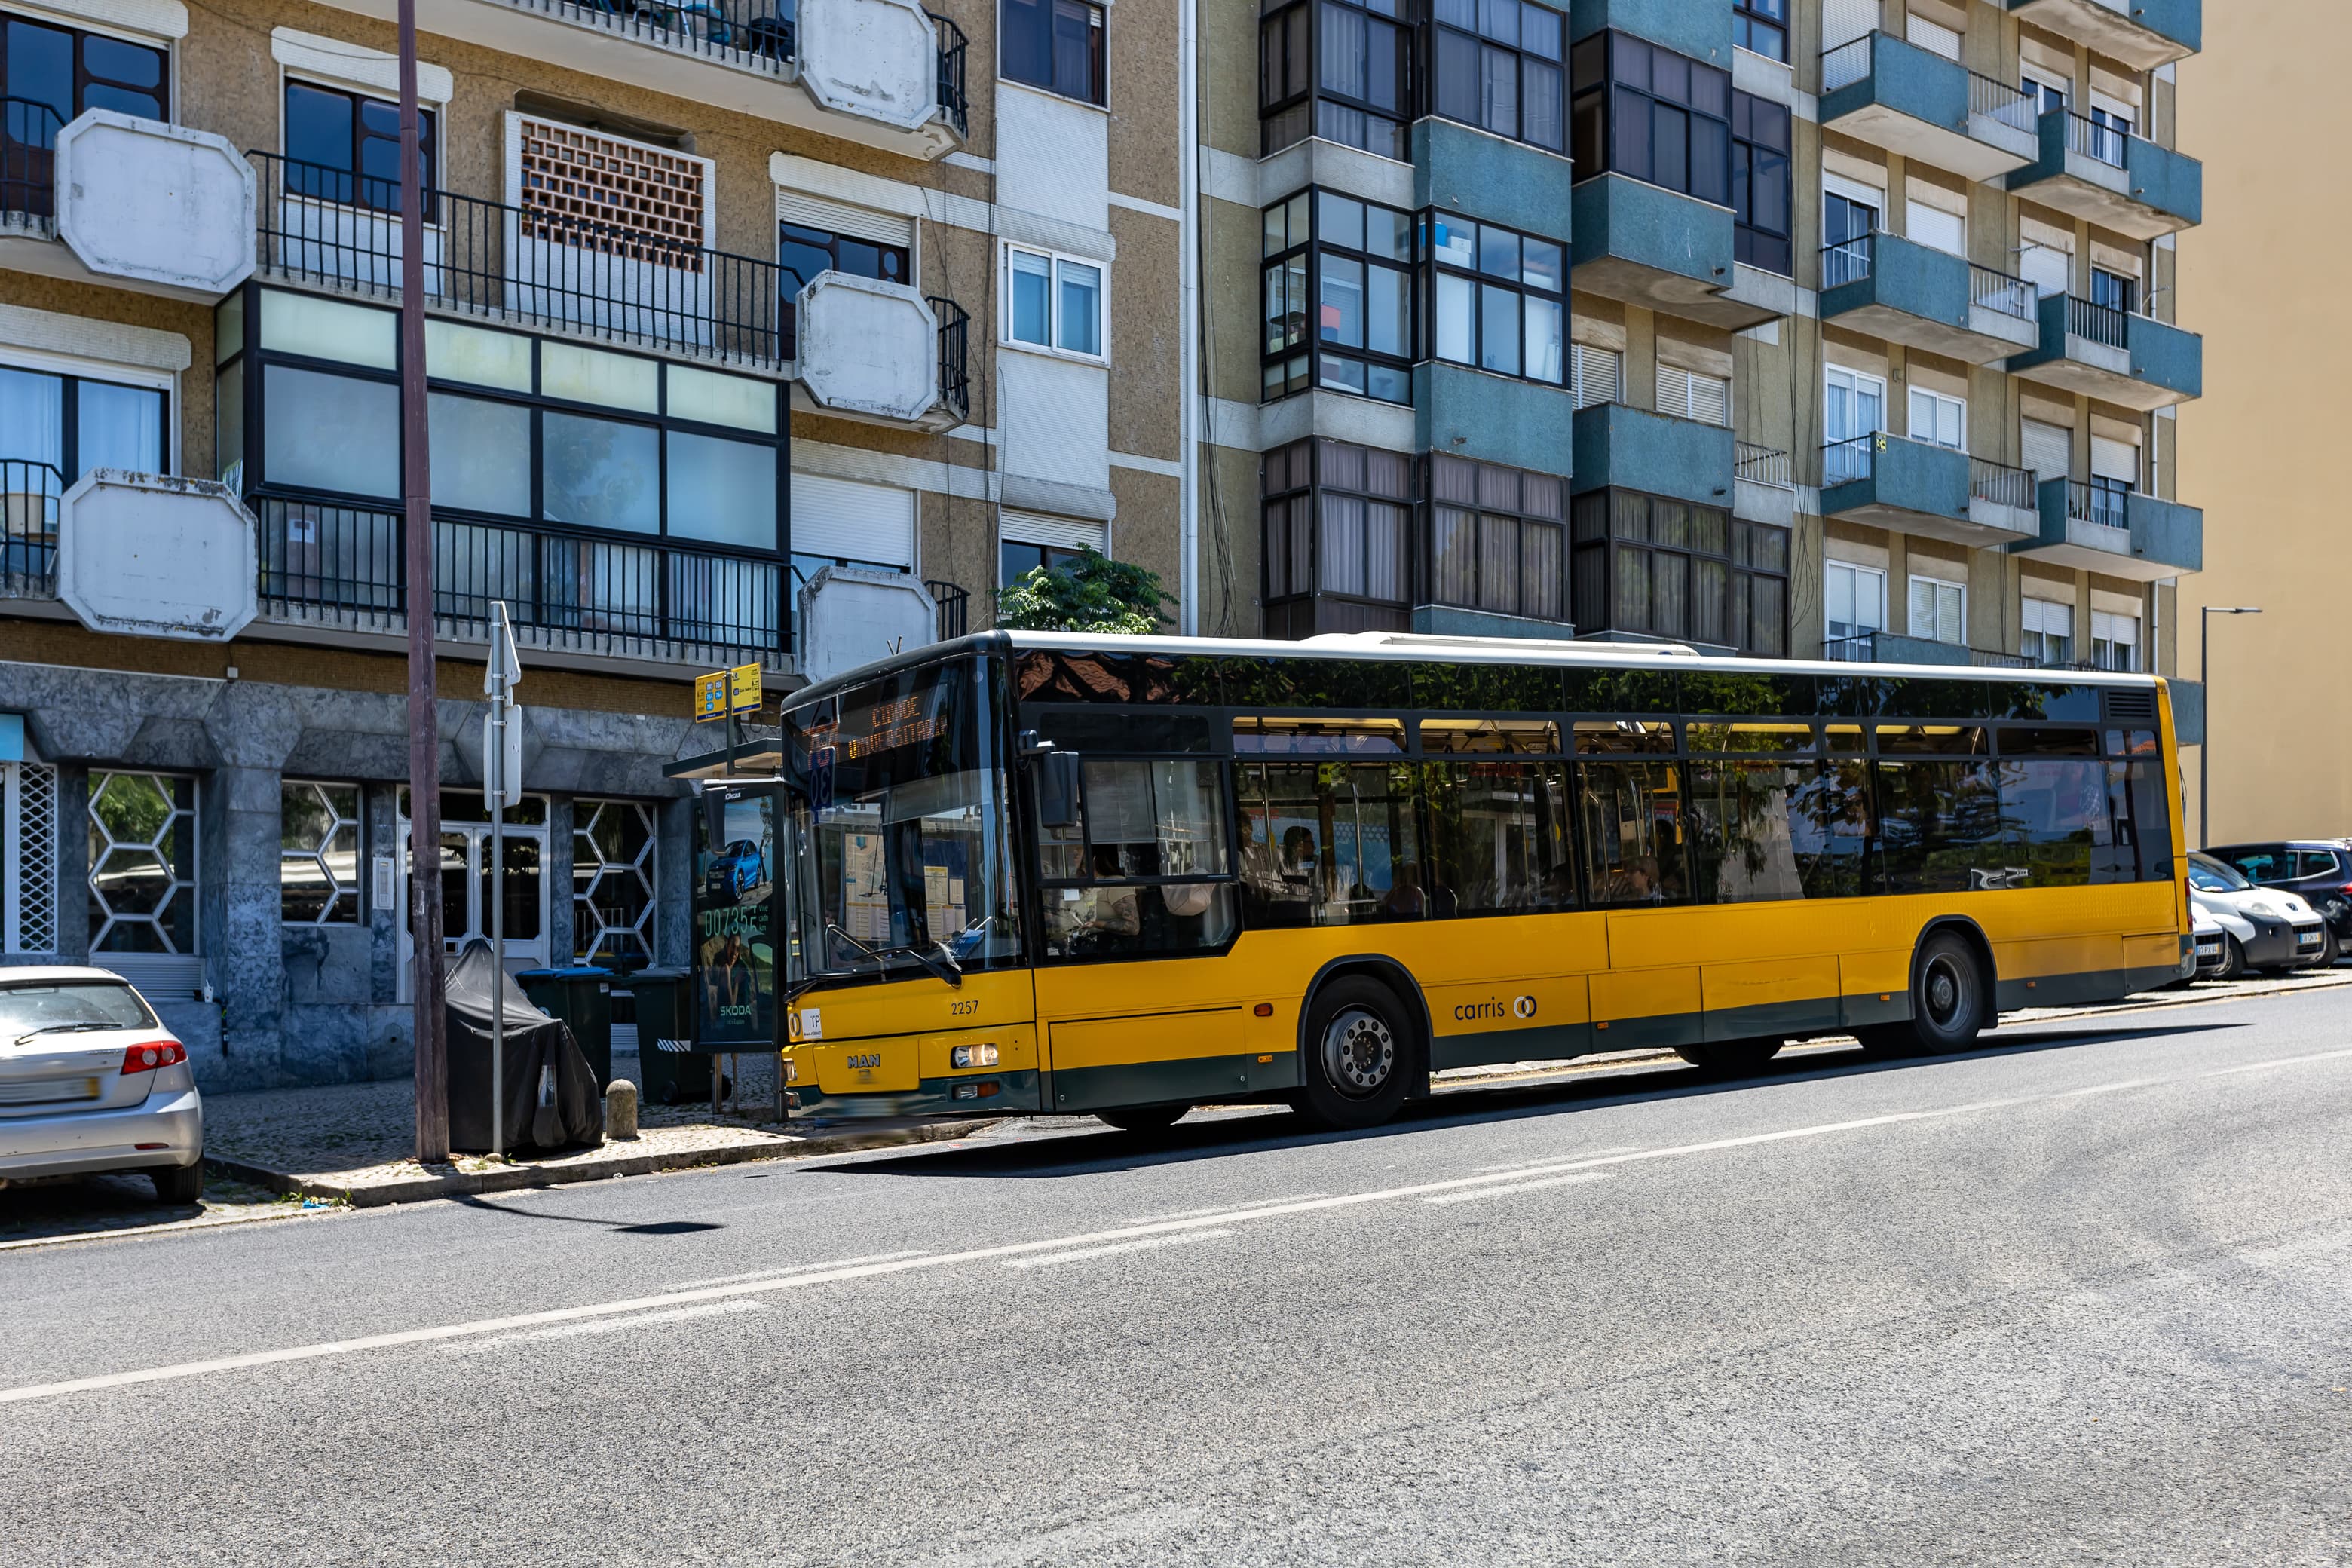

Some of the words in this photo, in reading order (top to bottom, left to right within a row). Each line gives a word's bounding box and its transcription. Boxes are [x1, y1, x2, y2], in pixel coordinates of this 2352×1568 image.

[872, 696, 920, 727] CIDADE
[951, 1000, 978, 1015] 2257
[1454, 996, 1505, 1021] carris
[810, 1015, 820, 1028] TP
[847, 1053, 880, 1069] MAN
